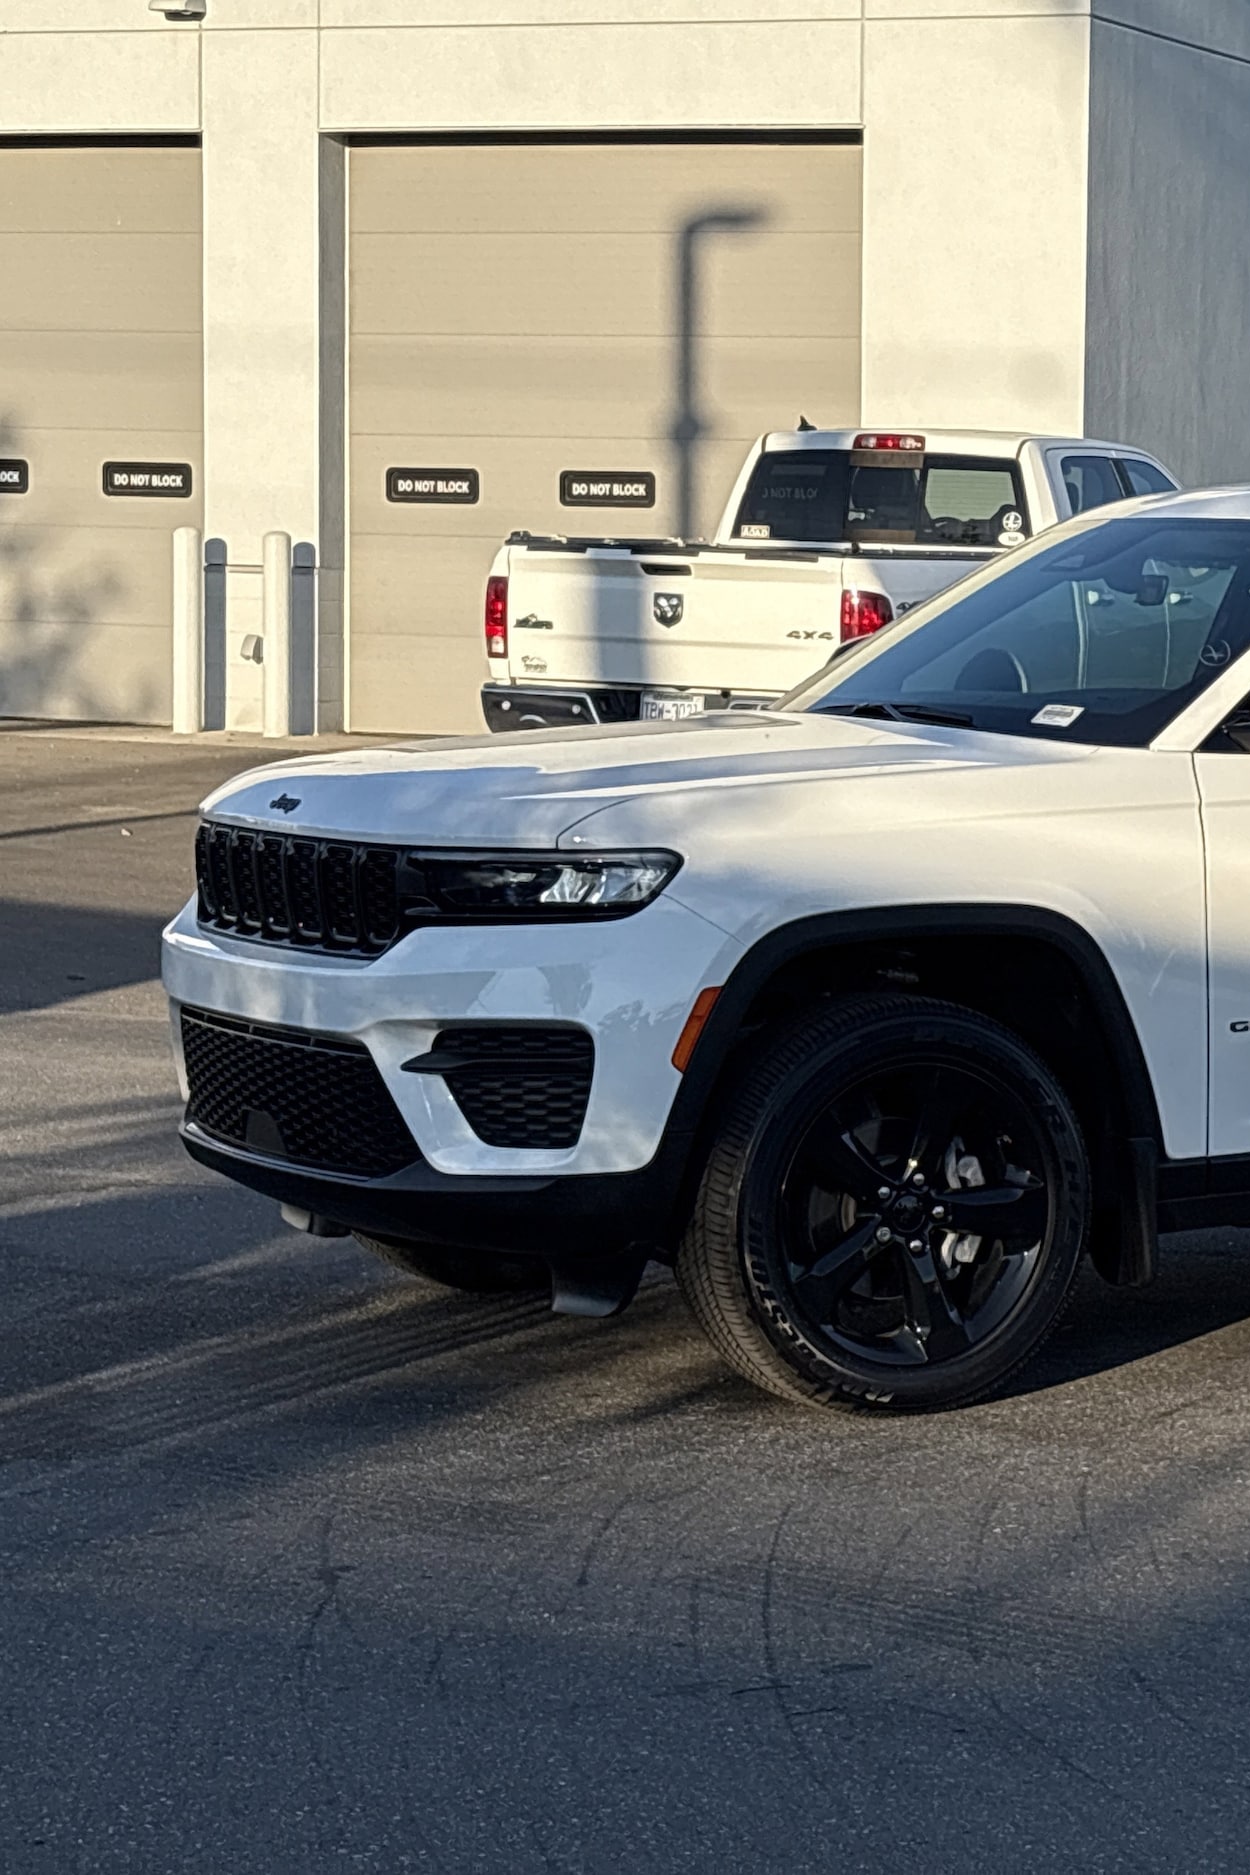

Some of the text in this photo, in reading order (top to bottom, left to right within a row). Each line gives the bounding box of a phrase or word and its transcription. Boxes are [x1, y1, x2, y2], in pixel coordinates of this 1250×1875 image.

[0, 470, 20, 483] OCK
[113, 473, 183, 488] DO NOT BLOCK
[397, 479, 470, 494] DO NOT BLOCK
[571, 483, 647, 497] DO NOT BLOCK
